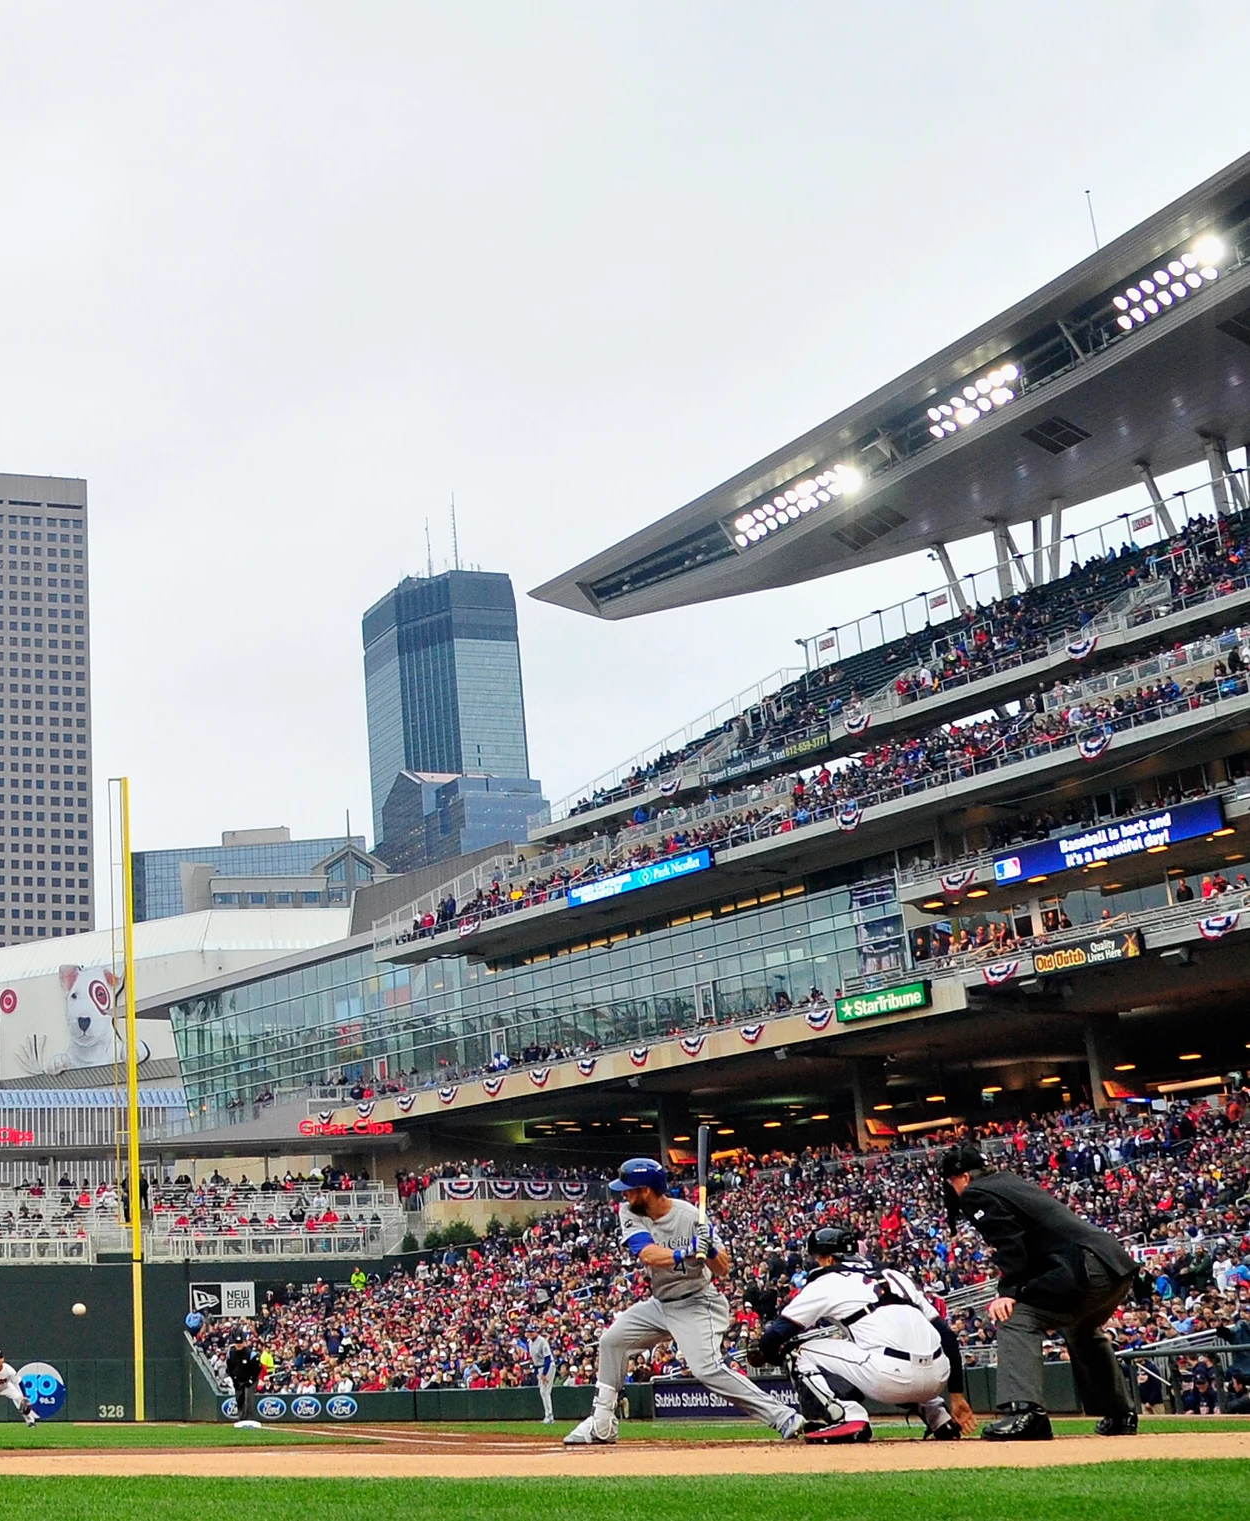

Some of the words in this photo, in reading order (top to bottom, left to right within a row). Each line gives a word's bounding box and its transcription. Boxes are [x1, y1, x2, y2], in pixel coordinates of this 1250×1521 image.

[727, 762, 750, 777] Security
[1059, 830, 1108, 853] Baseball
[1108, 827, 1120, 841] is
[1120, 820, 1149, 838] back
[1149, 813, 1172, 829] and
[1084, 850, 1093, 863] a
[1092, 836, 1144, 860] beautiful
[1087, 950, 1105, 963] Lives
[1105, 947, 1122, 960] Here
[1090, 940, 1115, 954] Quality
[1034, 954, 1054, 973] Old
[1054, 947, 1086, 969] Dutch
[853, 989, 922, 1016] StarTribune
[298, 1119, 349, 1136] Great
[352, 1119, 394, 1136] Clips
[673, 1259, 687, 1275] 4
[226, 1289, 250, 1300] NEW
[226, 1299, 250, 1309] ERA
[331, 1400, 352, 1416] Ford
[654, 1392, 681, 1408] StubHub
[681, 1392, 710, 1408] StubHub
[98, 1404, 125, 1418] 328
[263, 1401, 281, 1416] Ford
[296, 1401, 316, 1416] Ford
